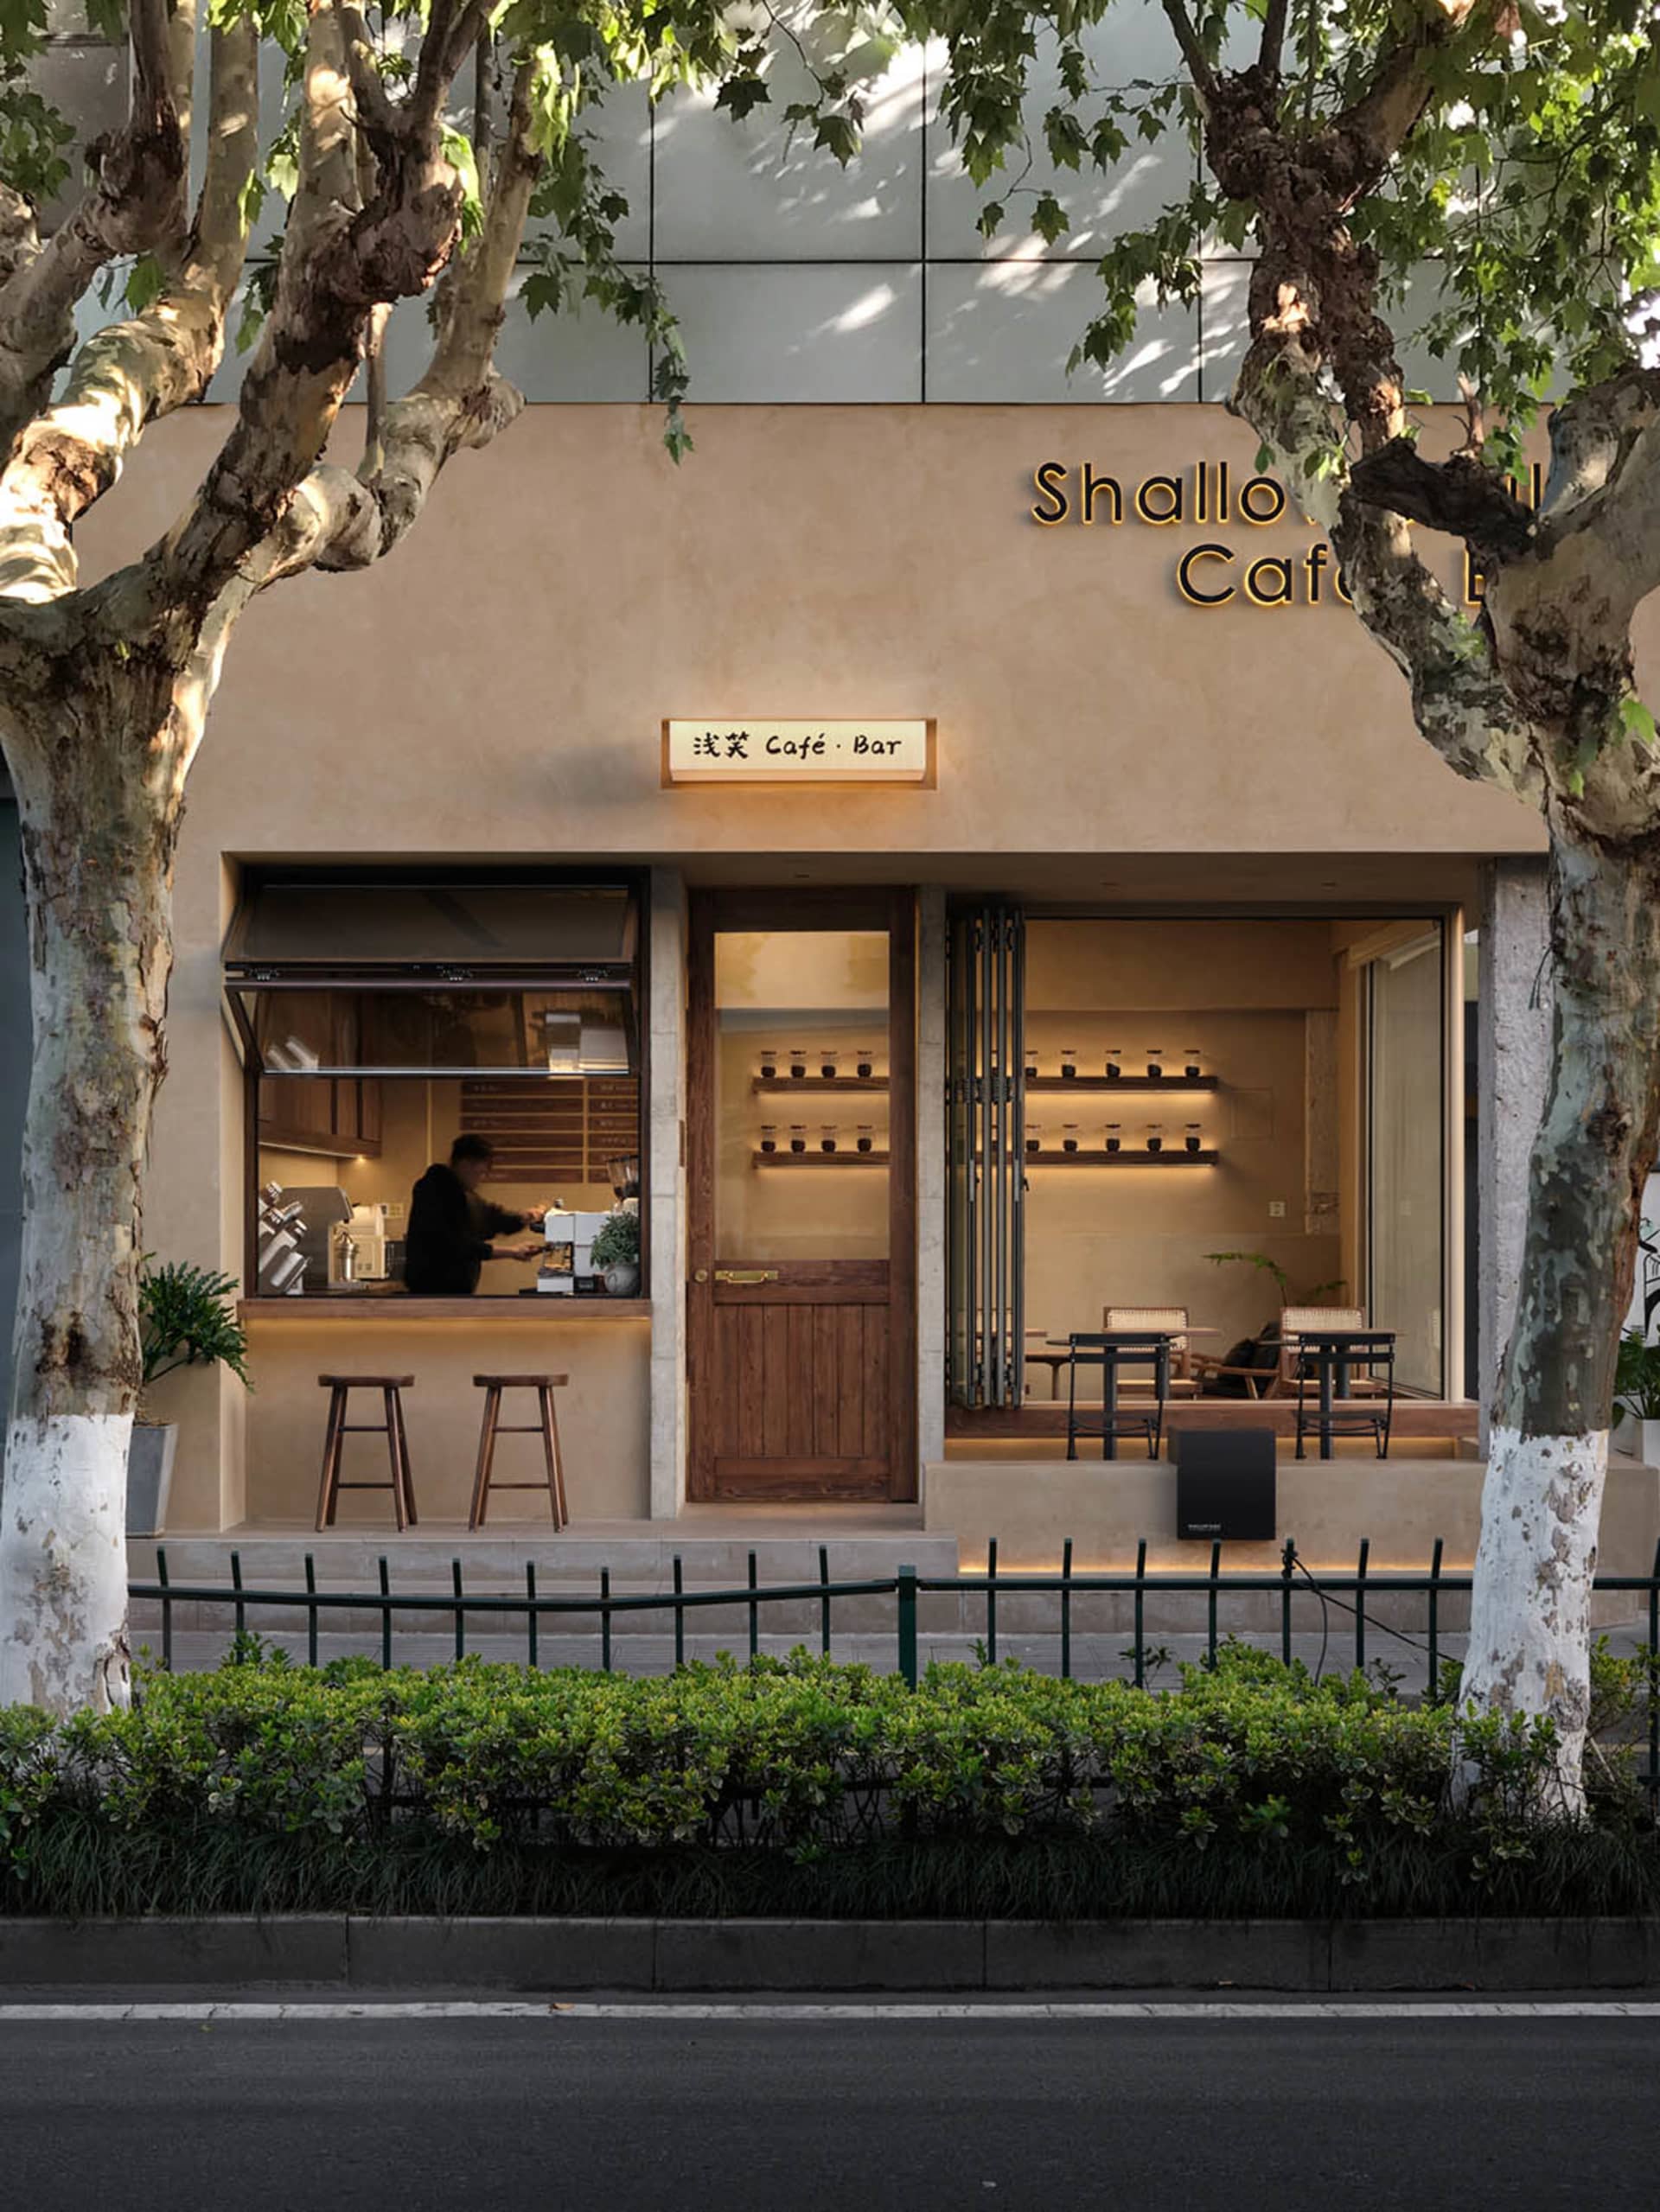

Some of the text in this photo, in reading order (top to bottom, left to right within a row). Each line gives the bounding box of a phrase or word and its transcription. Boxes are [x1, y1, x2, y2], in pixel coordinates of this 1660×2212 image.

[1032, 461, 1318, 524] Shallo
[693, 730, 750, 759] 浅笑
[765, 732, 826, 760] Café
[852, 735, 903, 755] Bar
